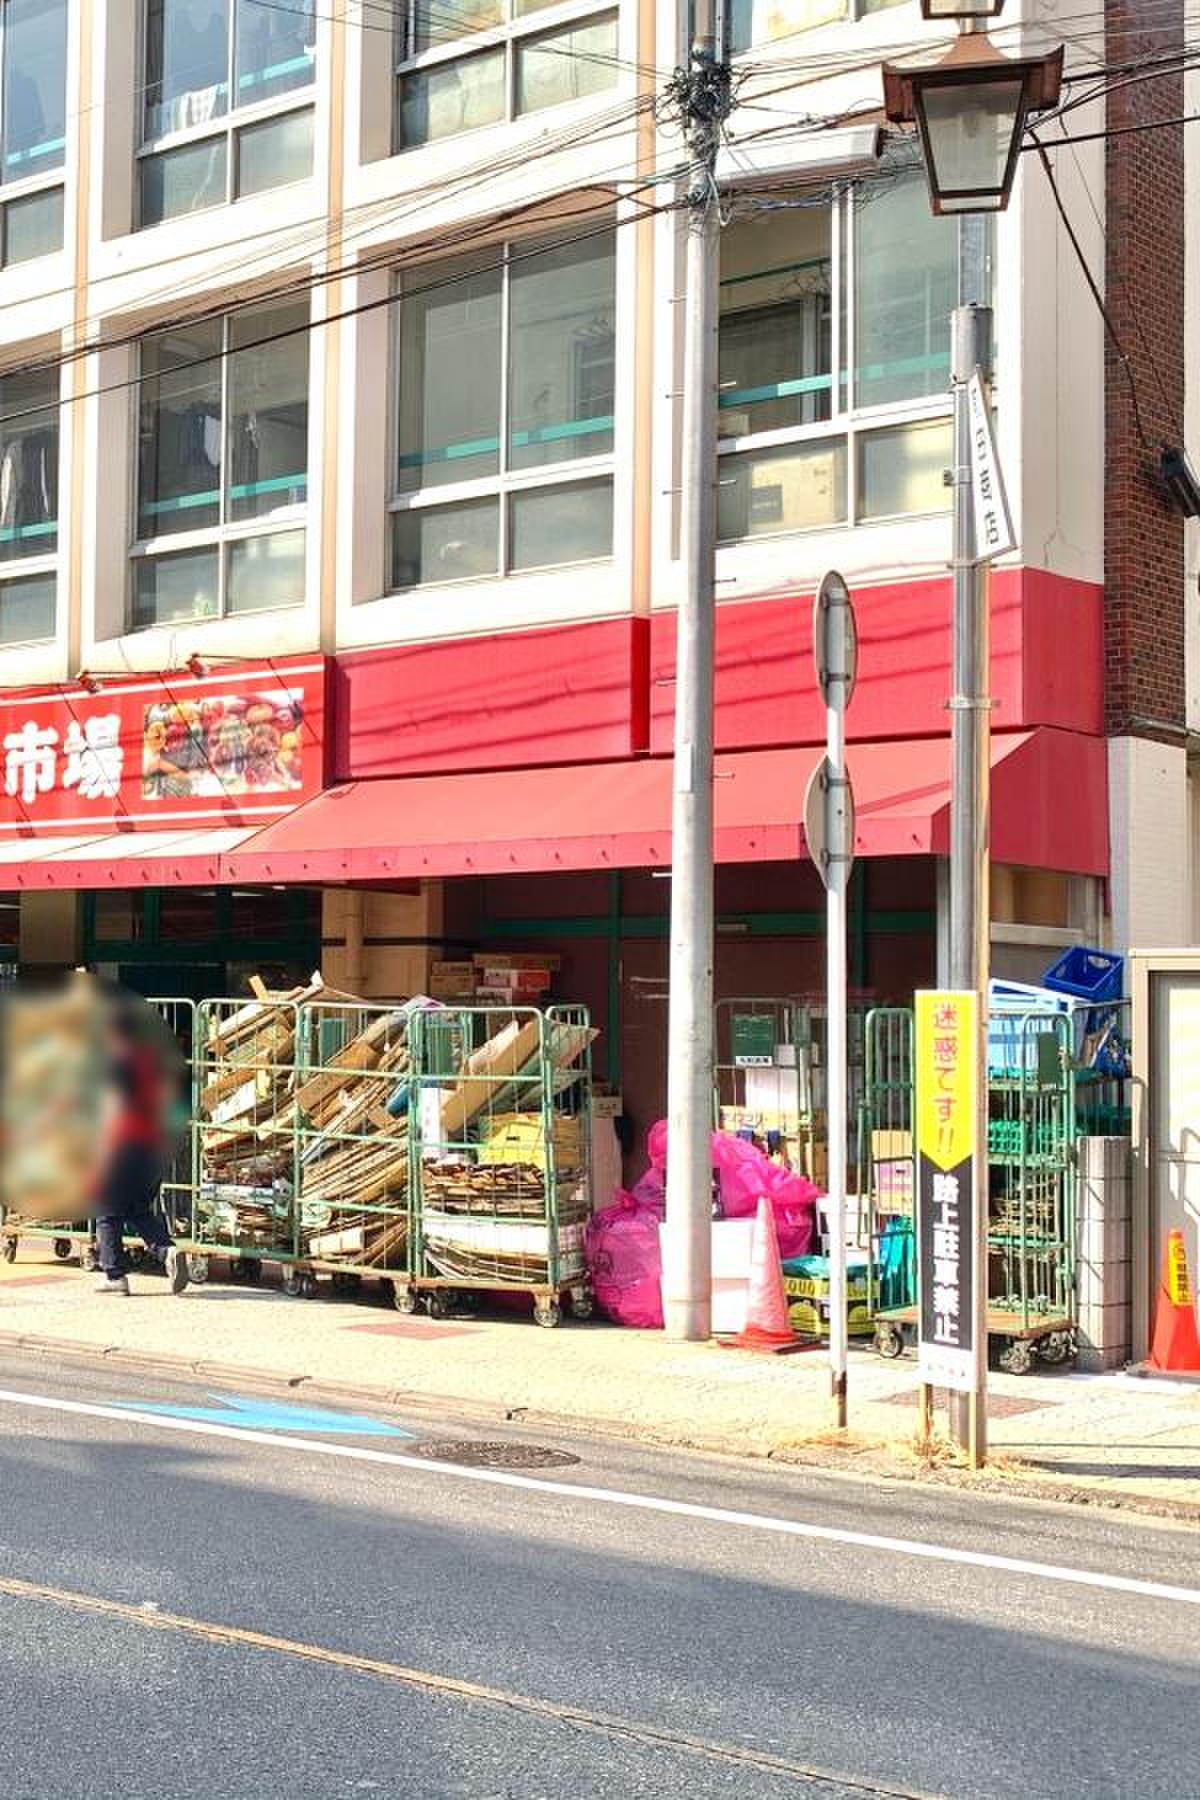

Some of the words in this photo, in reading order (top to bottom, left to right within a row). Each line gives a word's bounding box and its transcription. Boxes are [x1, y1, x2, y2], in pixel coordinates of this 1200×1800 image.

[932, 1173, 960, 1345] 路上駐車禁止
